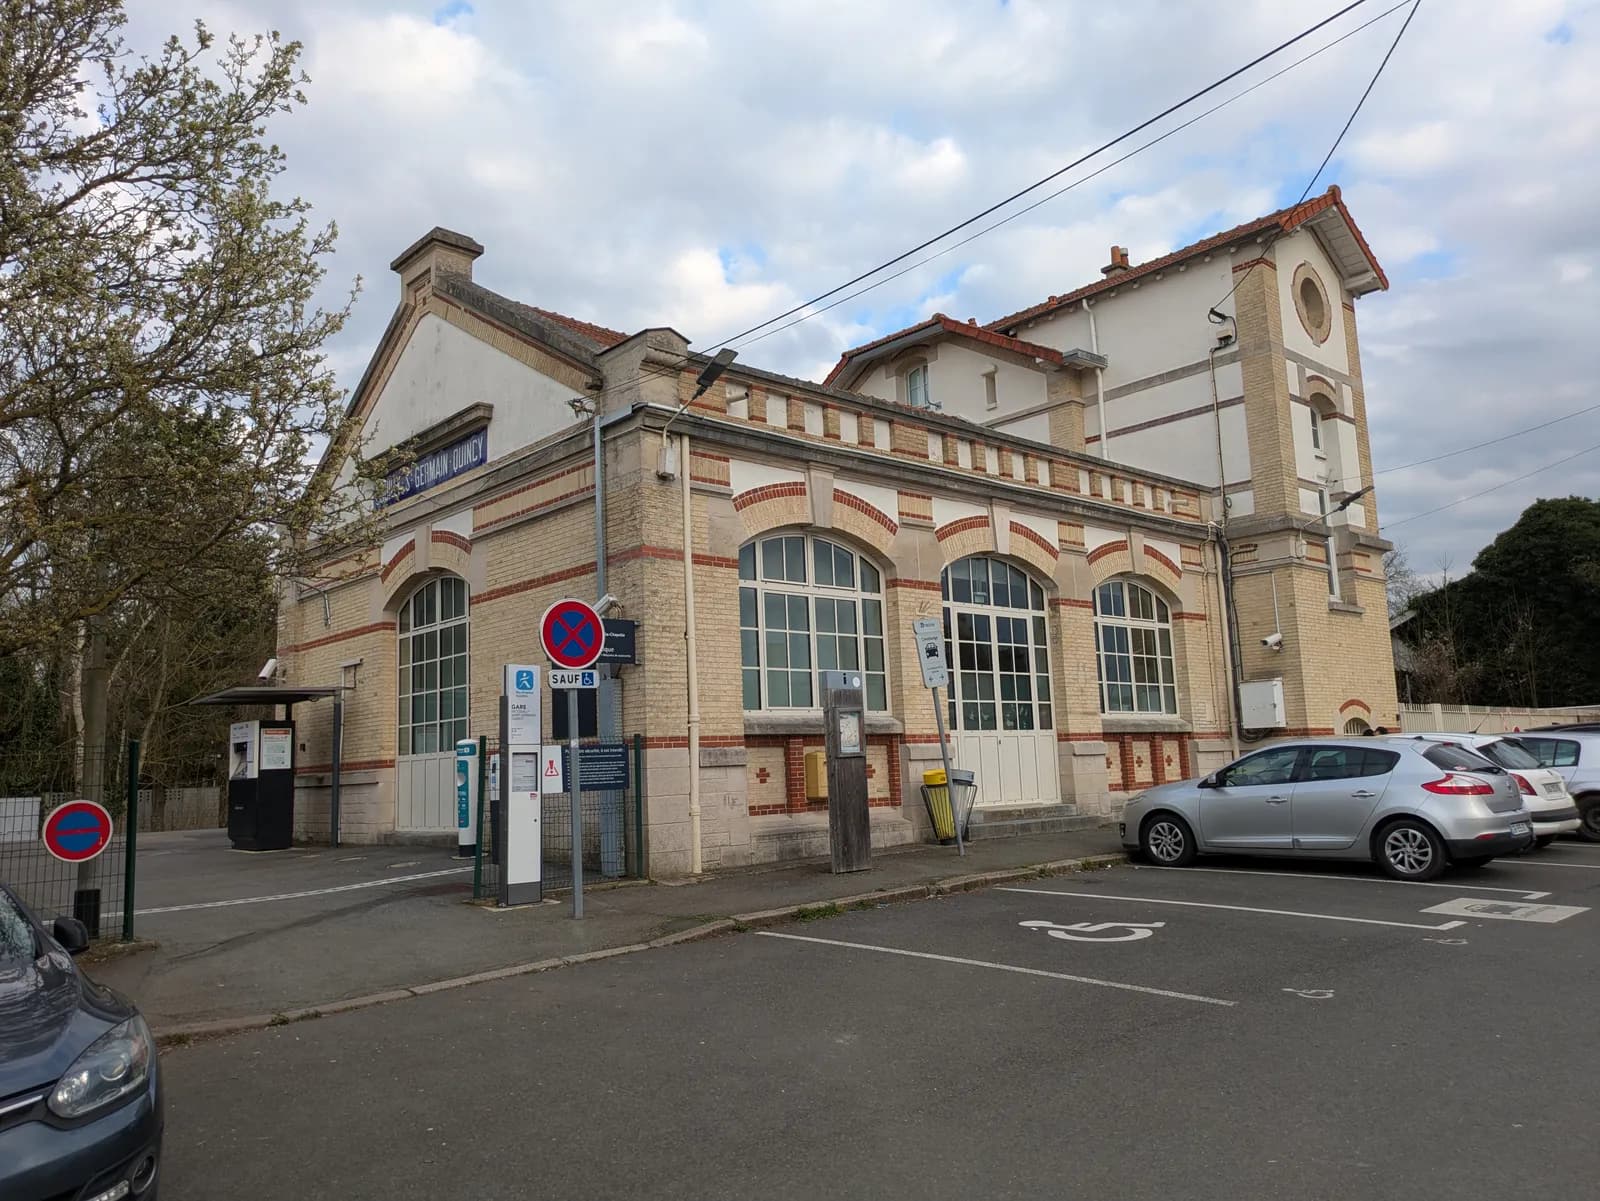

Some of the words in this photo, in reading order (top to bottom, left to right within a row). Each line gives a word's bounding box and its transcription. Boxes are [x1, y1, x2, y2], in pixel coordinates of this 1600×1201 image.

[414, 453, 449, 488] GERMAIN
[452, 435, 484, 473] QUINCY
[552, 674, 580, 684] SAUF
